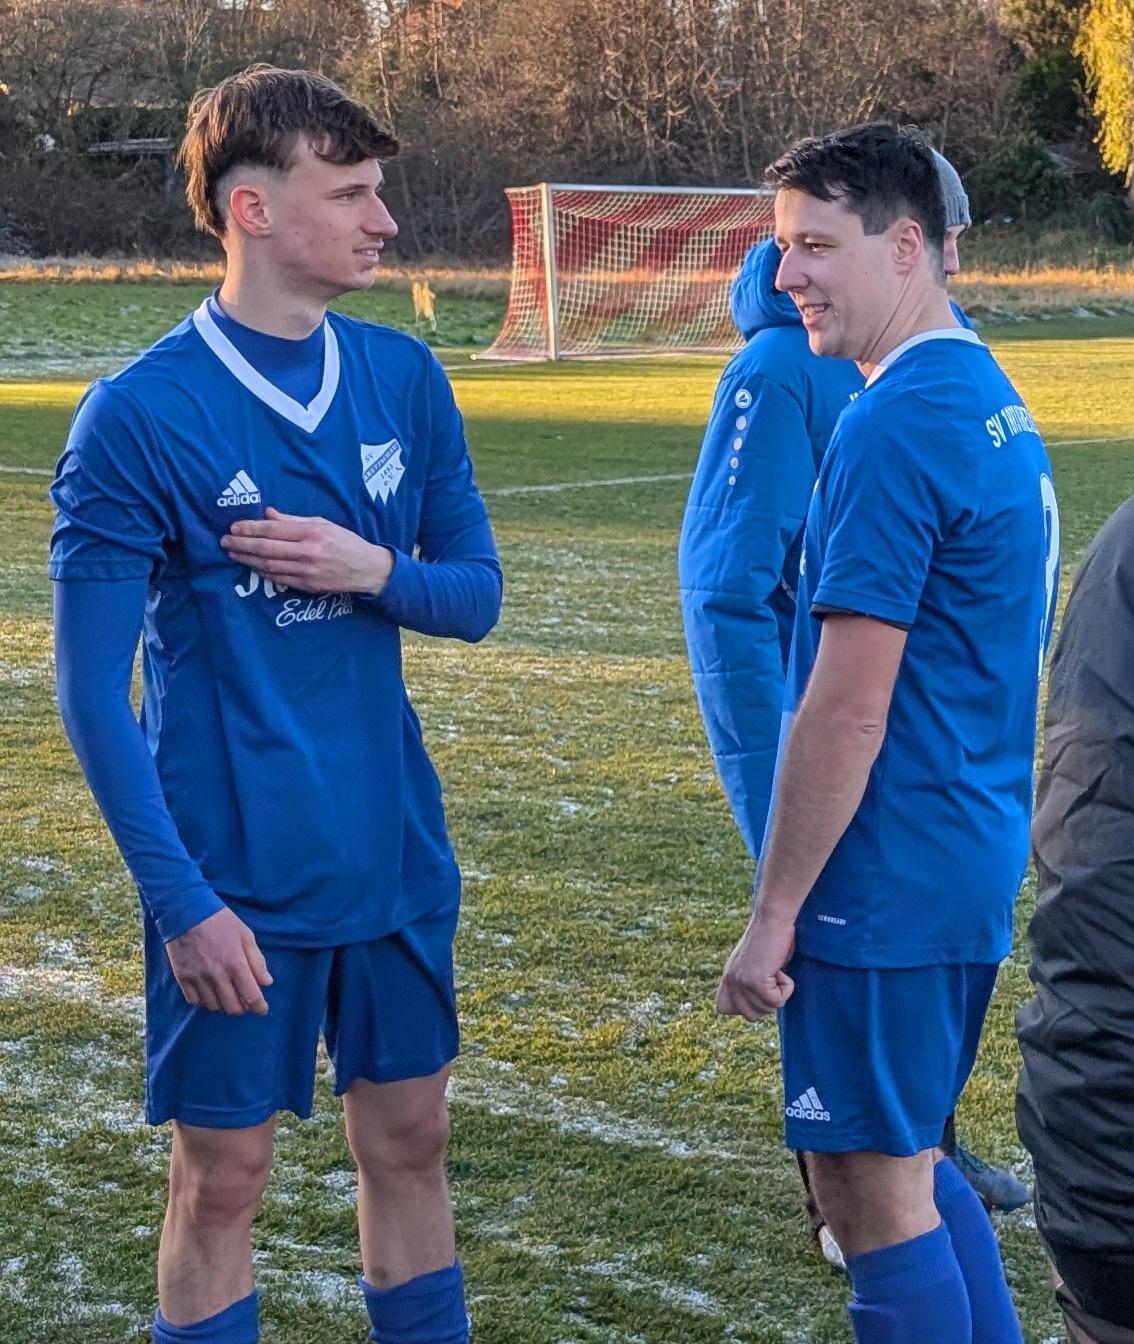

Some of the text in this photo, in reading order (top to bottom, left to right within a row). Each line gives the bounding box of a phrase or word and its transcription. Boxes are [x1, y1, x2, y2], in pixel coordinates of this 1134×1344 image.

[985, 412, 1008, 449] SV
[216, 491, 262, 507] adida
[275, 598, 328, 628] Edel
[785, 1106, 831, 1122] adidas
